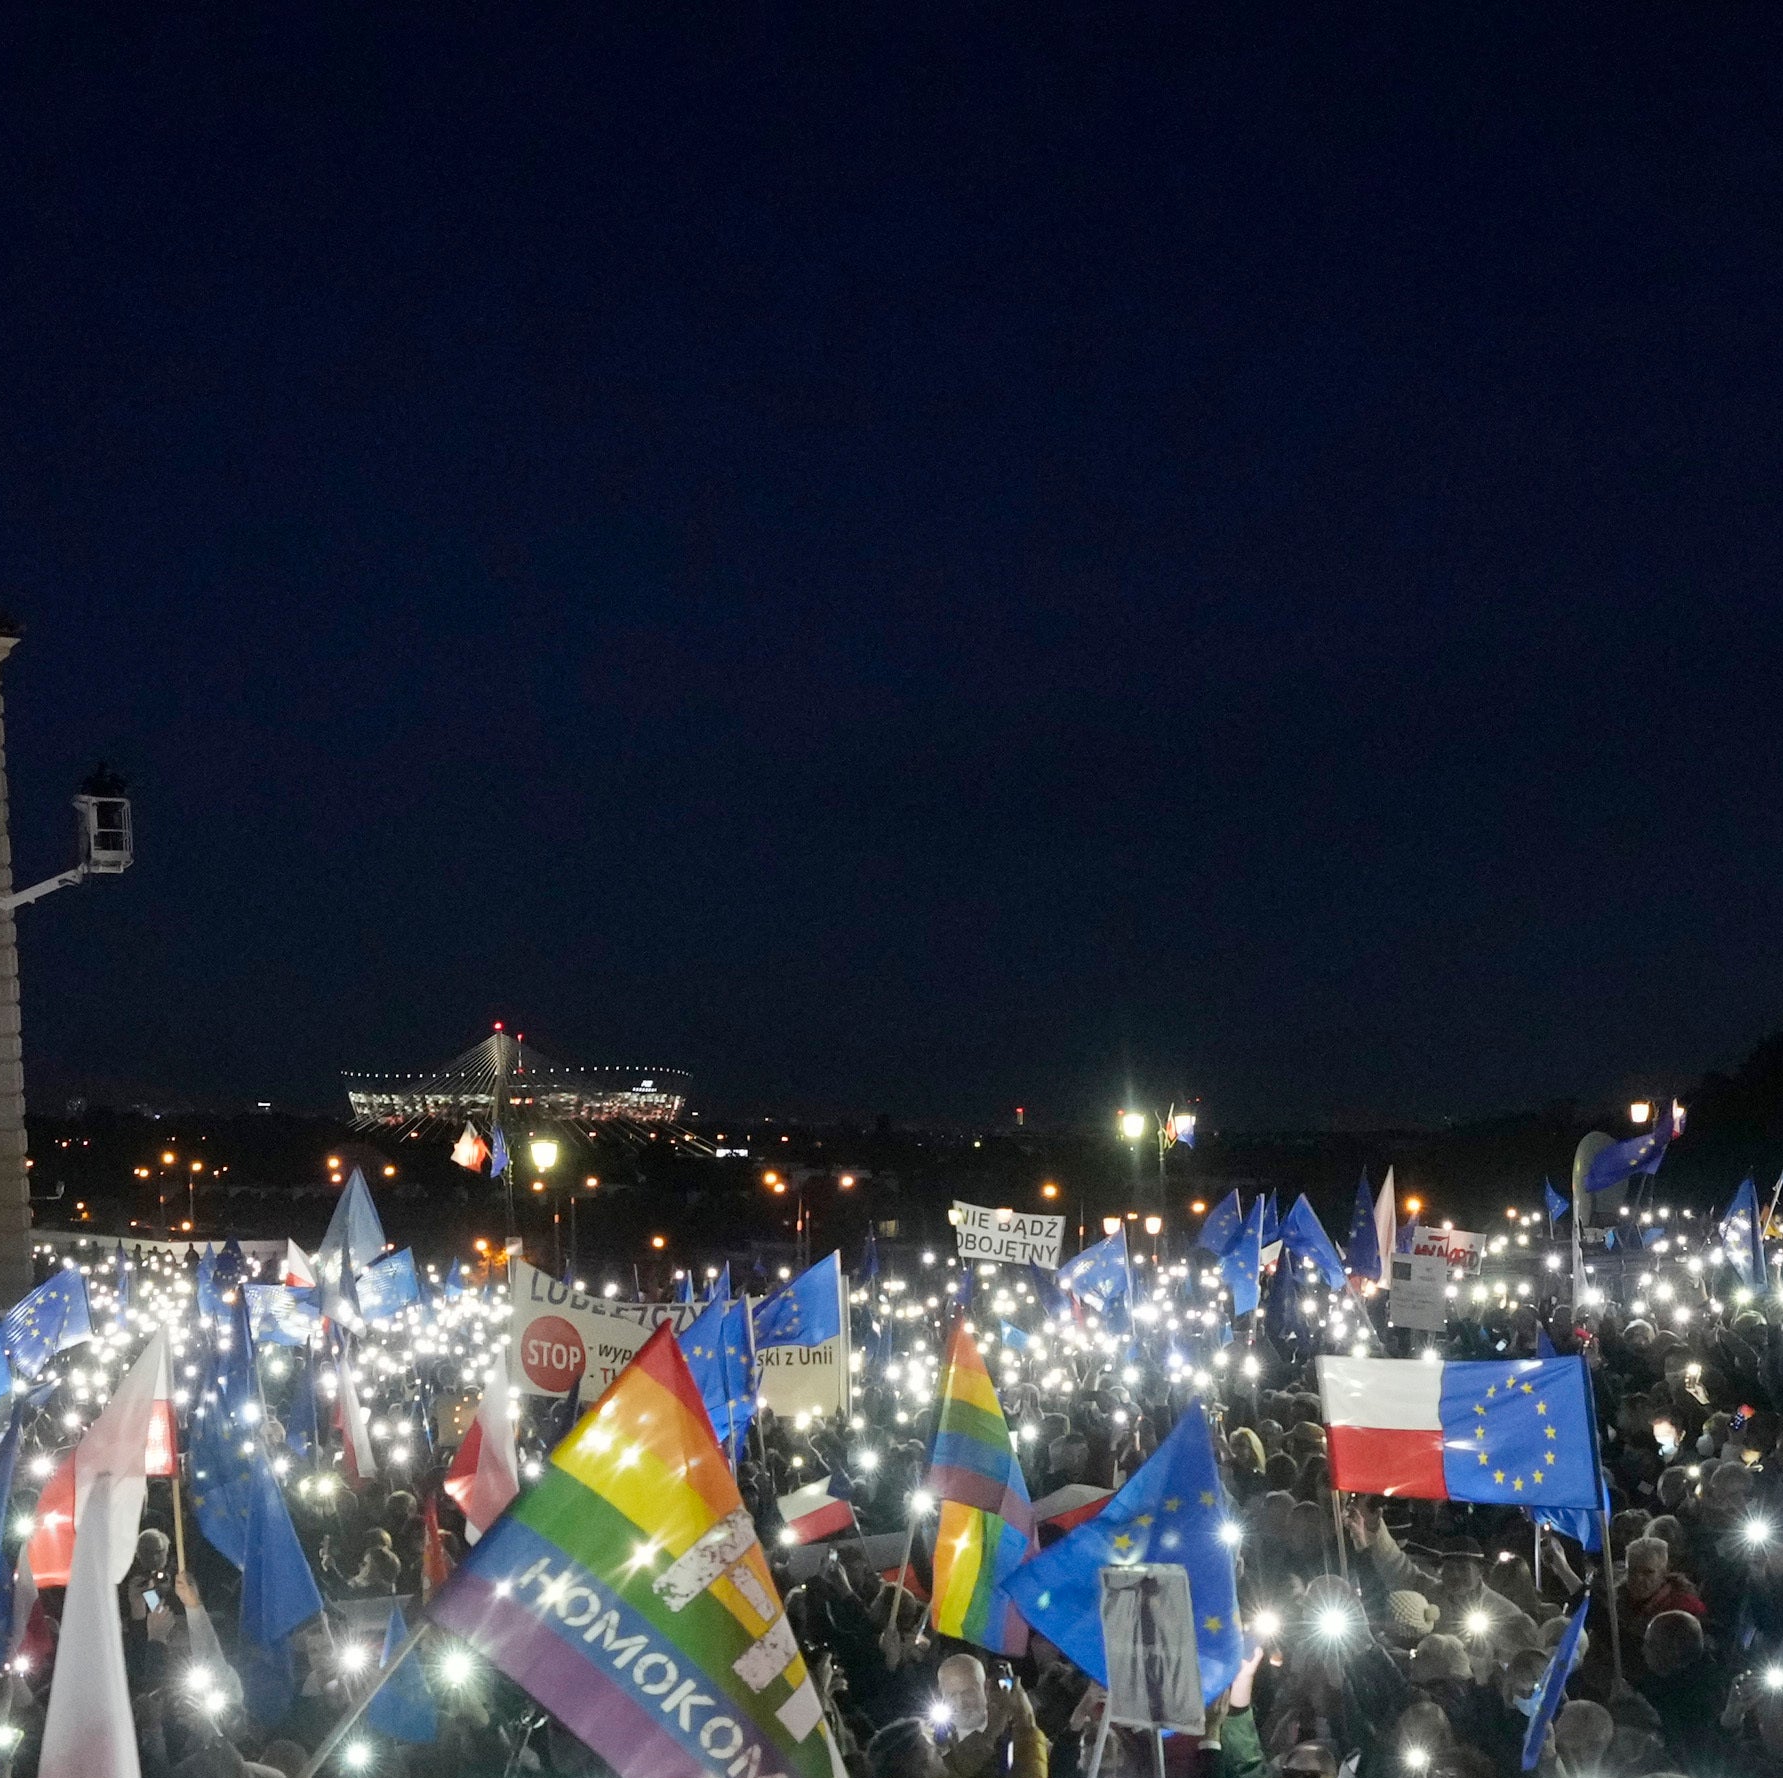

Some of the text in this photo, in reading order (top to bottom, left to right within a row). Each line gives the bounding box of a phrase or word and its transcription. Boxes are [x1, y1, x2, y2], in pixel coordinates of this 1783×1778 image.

[956, 1207, 991, 1230] NIE
[956, 1231, 1058, 1262] OBOJĘTNY
[526, 1340, 582, 1372] STOP
[784, 1352, 794, 1366] z
[798, 1346, 833, 1366] Unii
